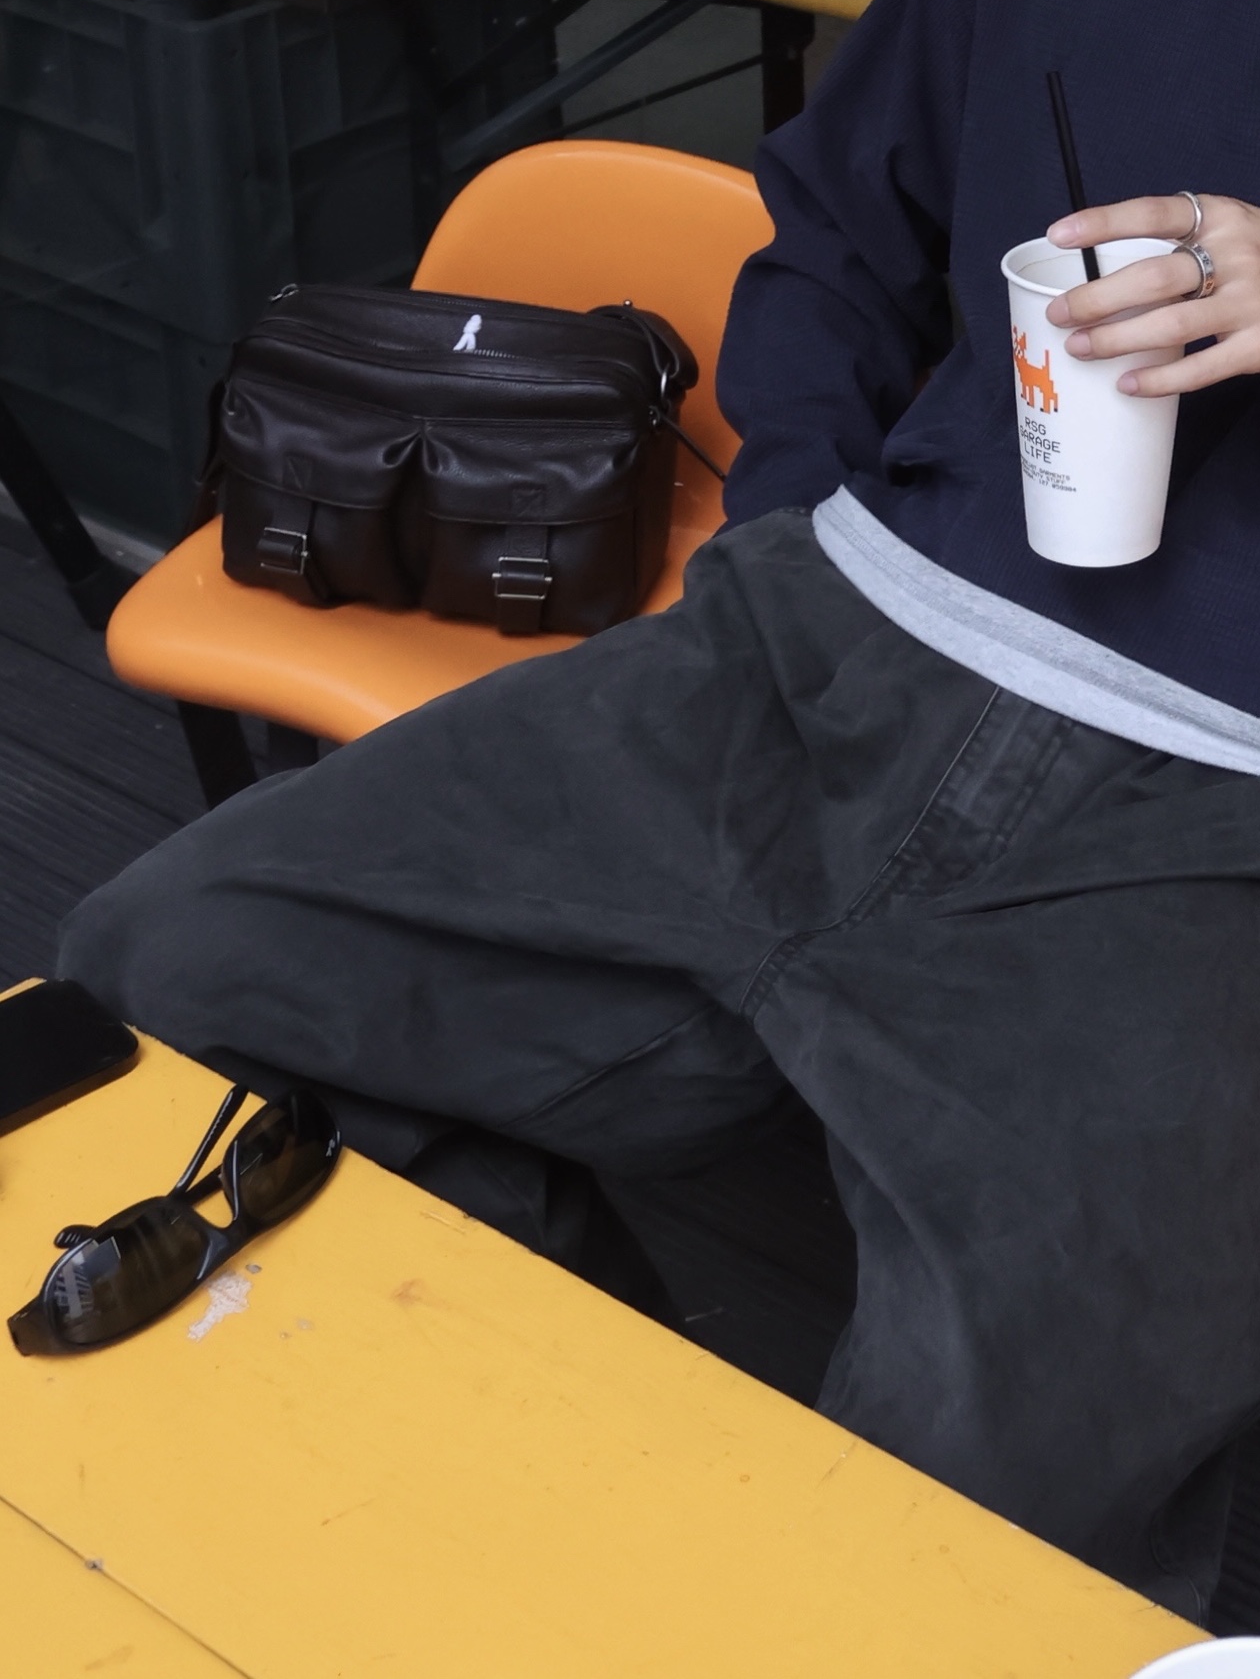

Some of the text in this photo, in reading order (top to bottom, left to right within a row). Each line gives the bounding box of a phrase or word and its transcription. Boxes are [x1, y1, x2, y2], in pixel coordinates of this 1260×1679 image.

[1024, 416, 1047, 436] RSG
[1020, 424, 1061, 453] GARAGE
[1024, 441, 1052, 464] LIFE
